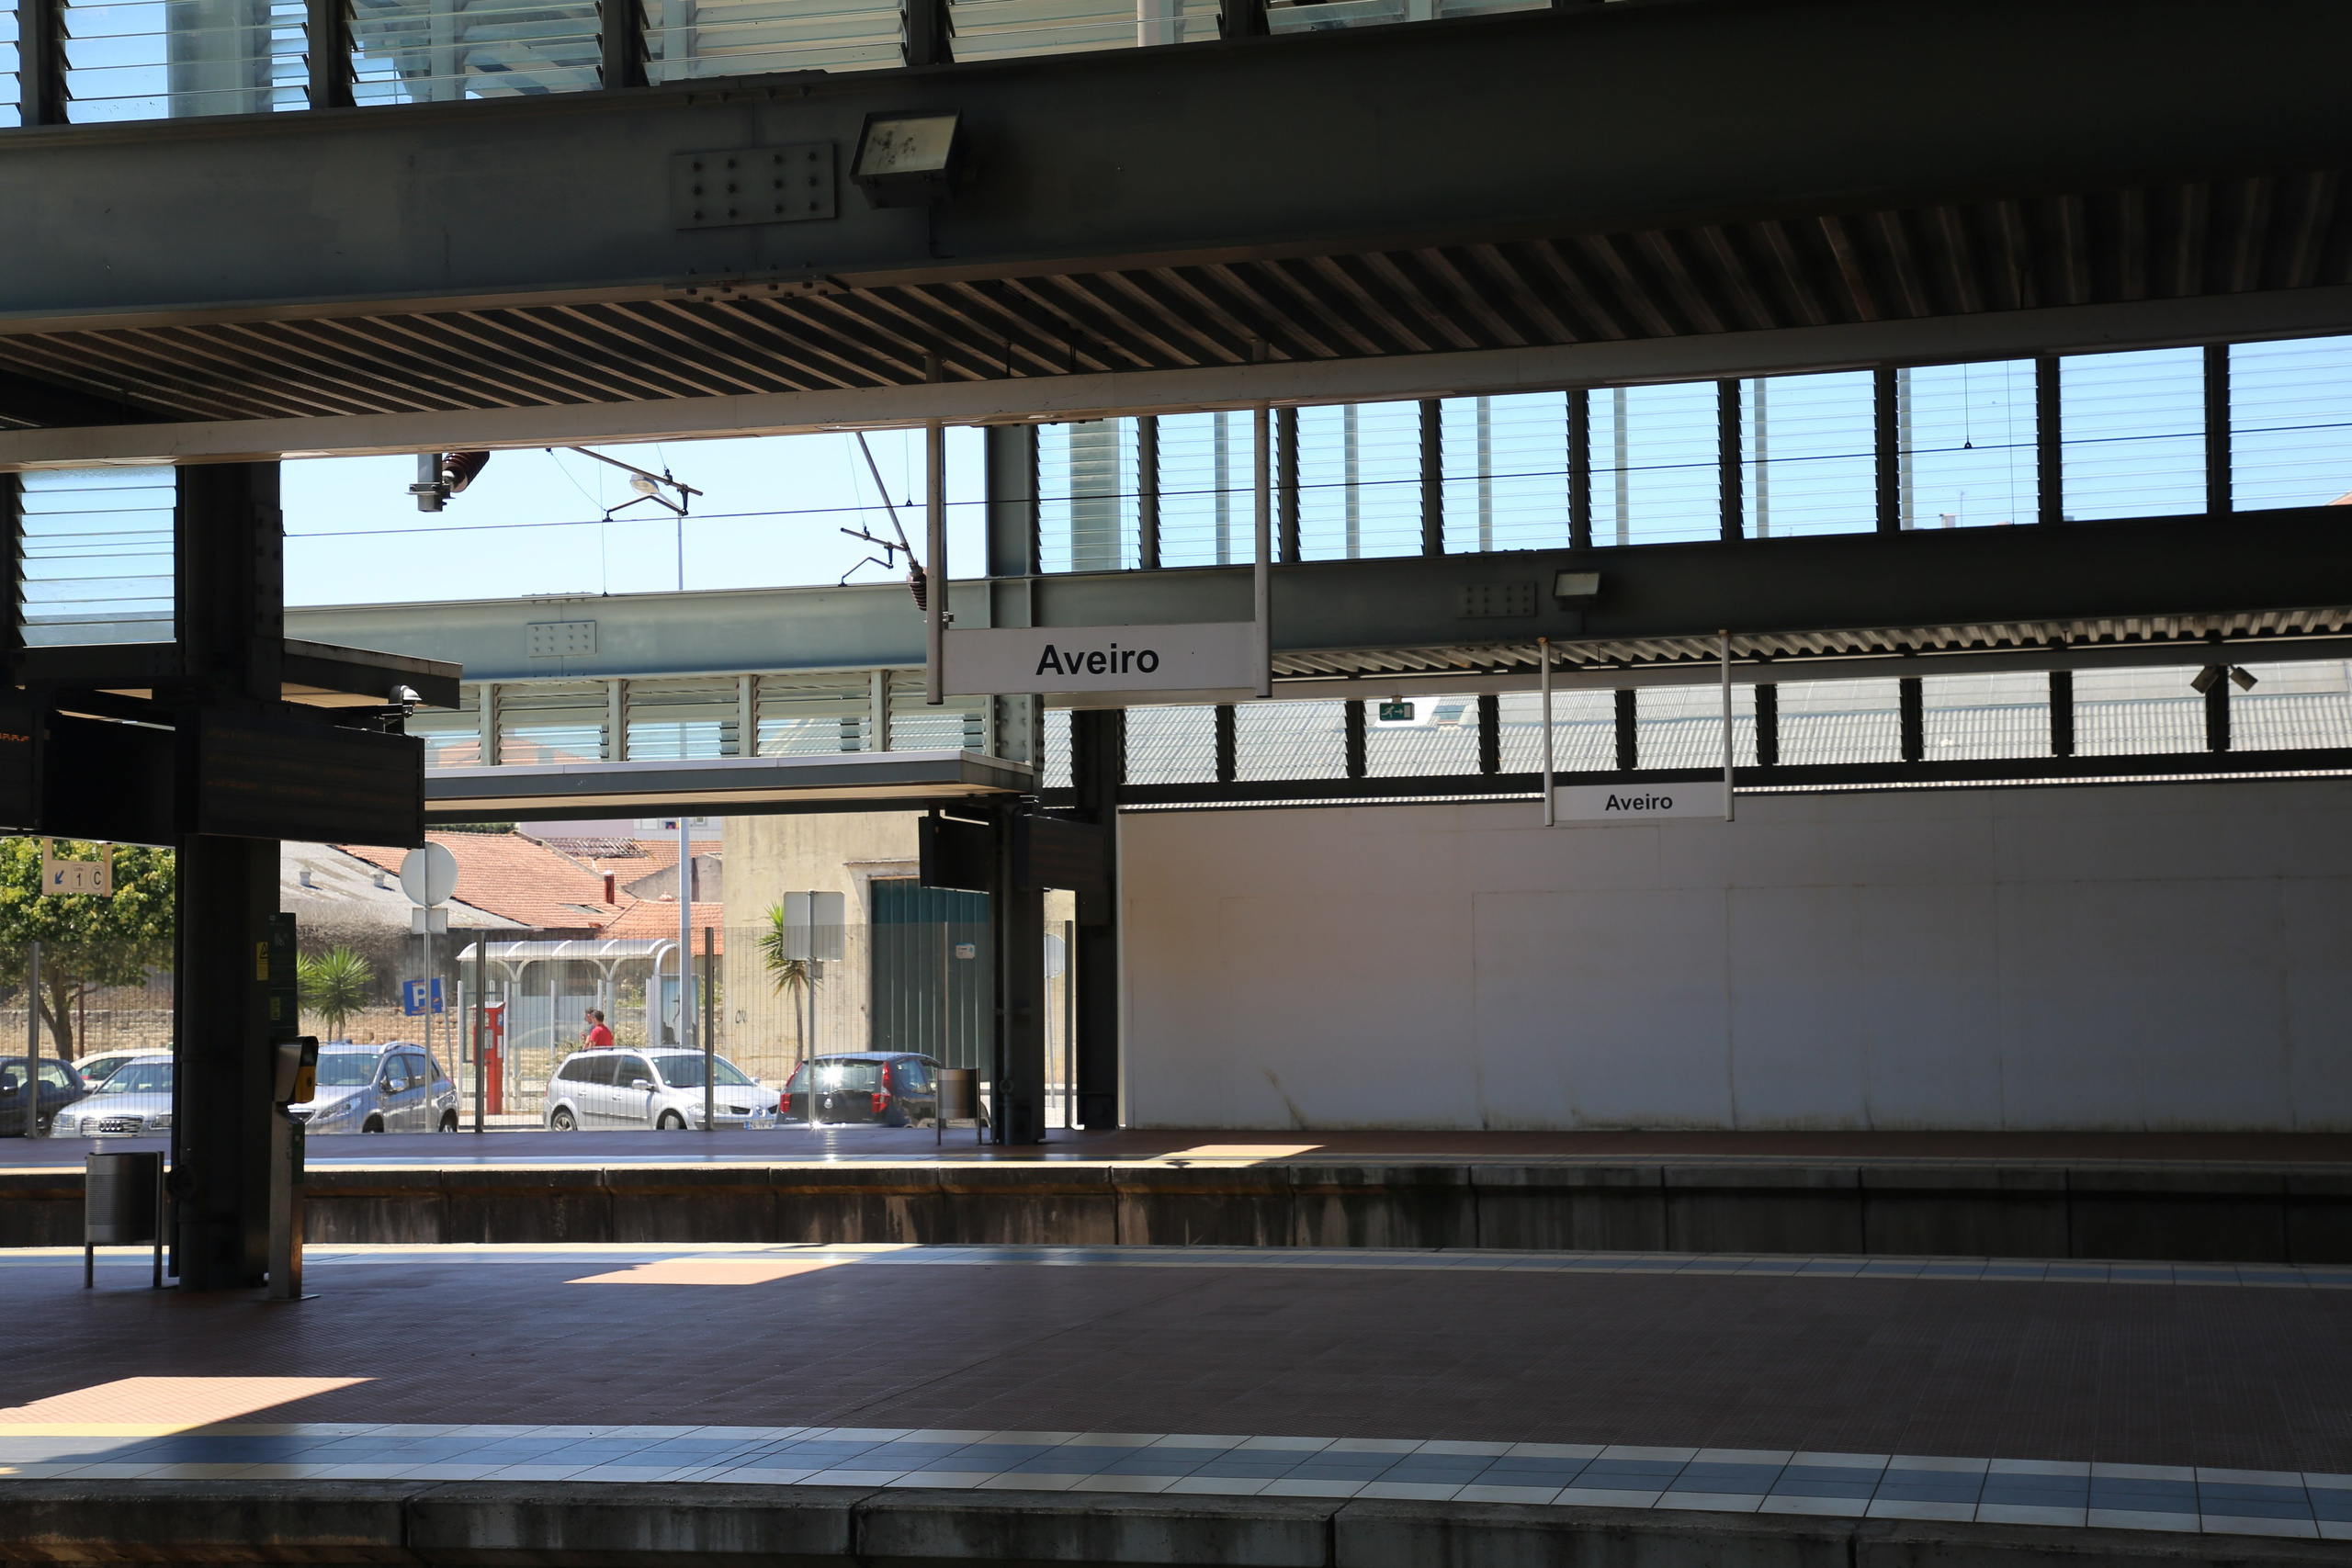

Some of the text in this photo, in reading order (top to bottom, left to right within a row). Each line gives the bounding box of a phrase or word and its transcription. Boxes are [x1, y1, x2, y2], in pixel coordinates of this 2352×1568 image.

[1035, 643, 1159, 675] Aveiro
[1605, 794, 1673, 810] Aveiro
[76, 871, 101, 887] 1 C
[413, 986, 426, 1007] P
